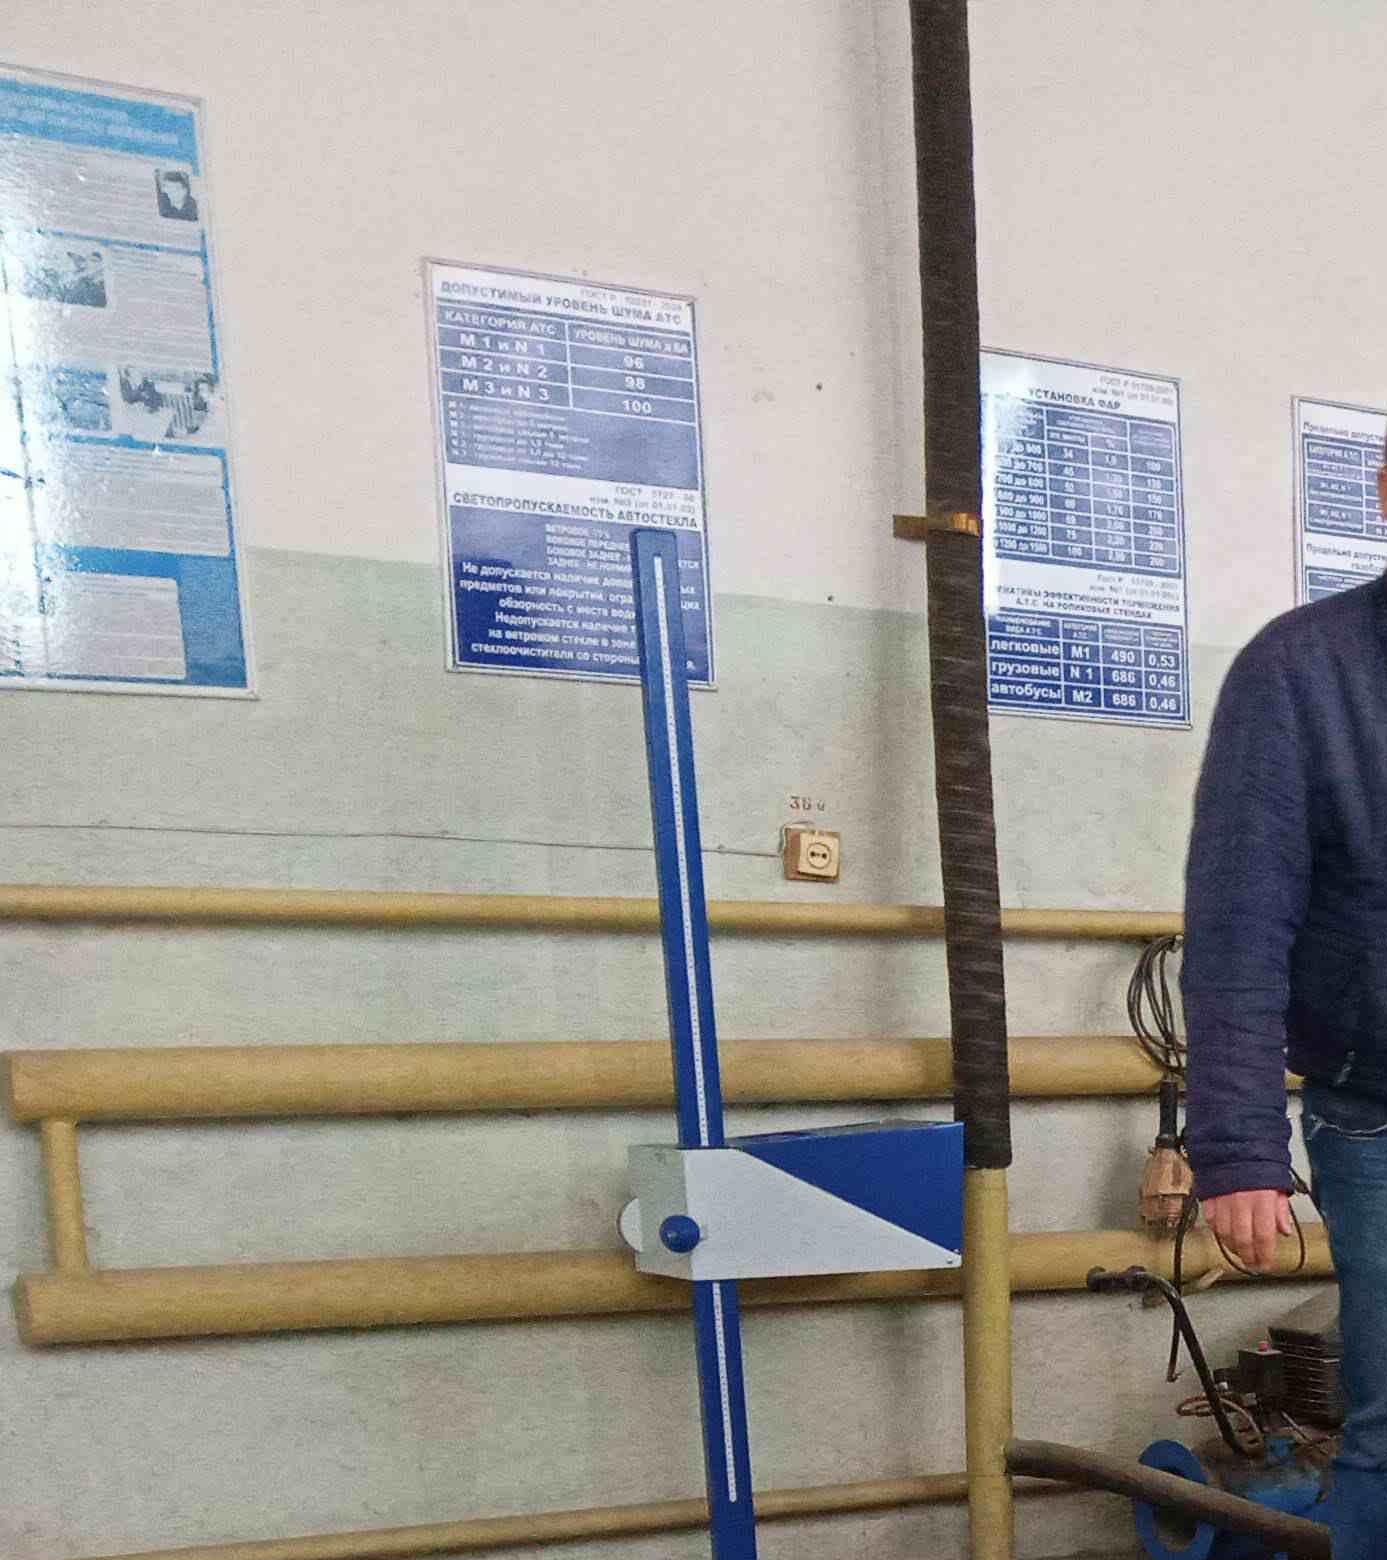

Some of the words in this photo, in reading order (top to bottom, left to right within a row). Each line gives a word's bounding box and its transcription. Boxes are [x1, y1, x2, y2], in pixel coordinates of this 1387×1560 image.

[440, 280, 541, 305] ДОПУСТИМЫЙ
[545, 295, 608, 315] УРОВЕНЬ
[611, 305, 652, 321] ШУМА
[655, 310, 682, 326] АТС
[444, 310, 526, 332] КАТЕГОРИЯ
[621, 399, 652, 415] 100
[453, 491, 614, 520] СВЕТОПРОПУСКАЕМОСТЬ
[617, 509, 698, 528] АВТОСТЕКЛА
[991, 639, 1059, 656] легковые
[1071, 645, 1091, 660] М1
[991, 660, 1060, 677] грузовые
[1148, 653, 1176, 669] 0,53
[1069, 666, 1081, 680] N
[1086, 667, 1093, 681] 1
[1149, 674, 1177, 690] 0,46
[991, 683, 1062, 701] автобусы
[1072, 690, 1093, 704] М2
